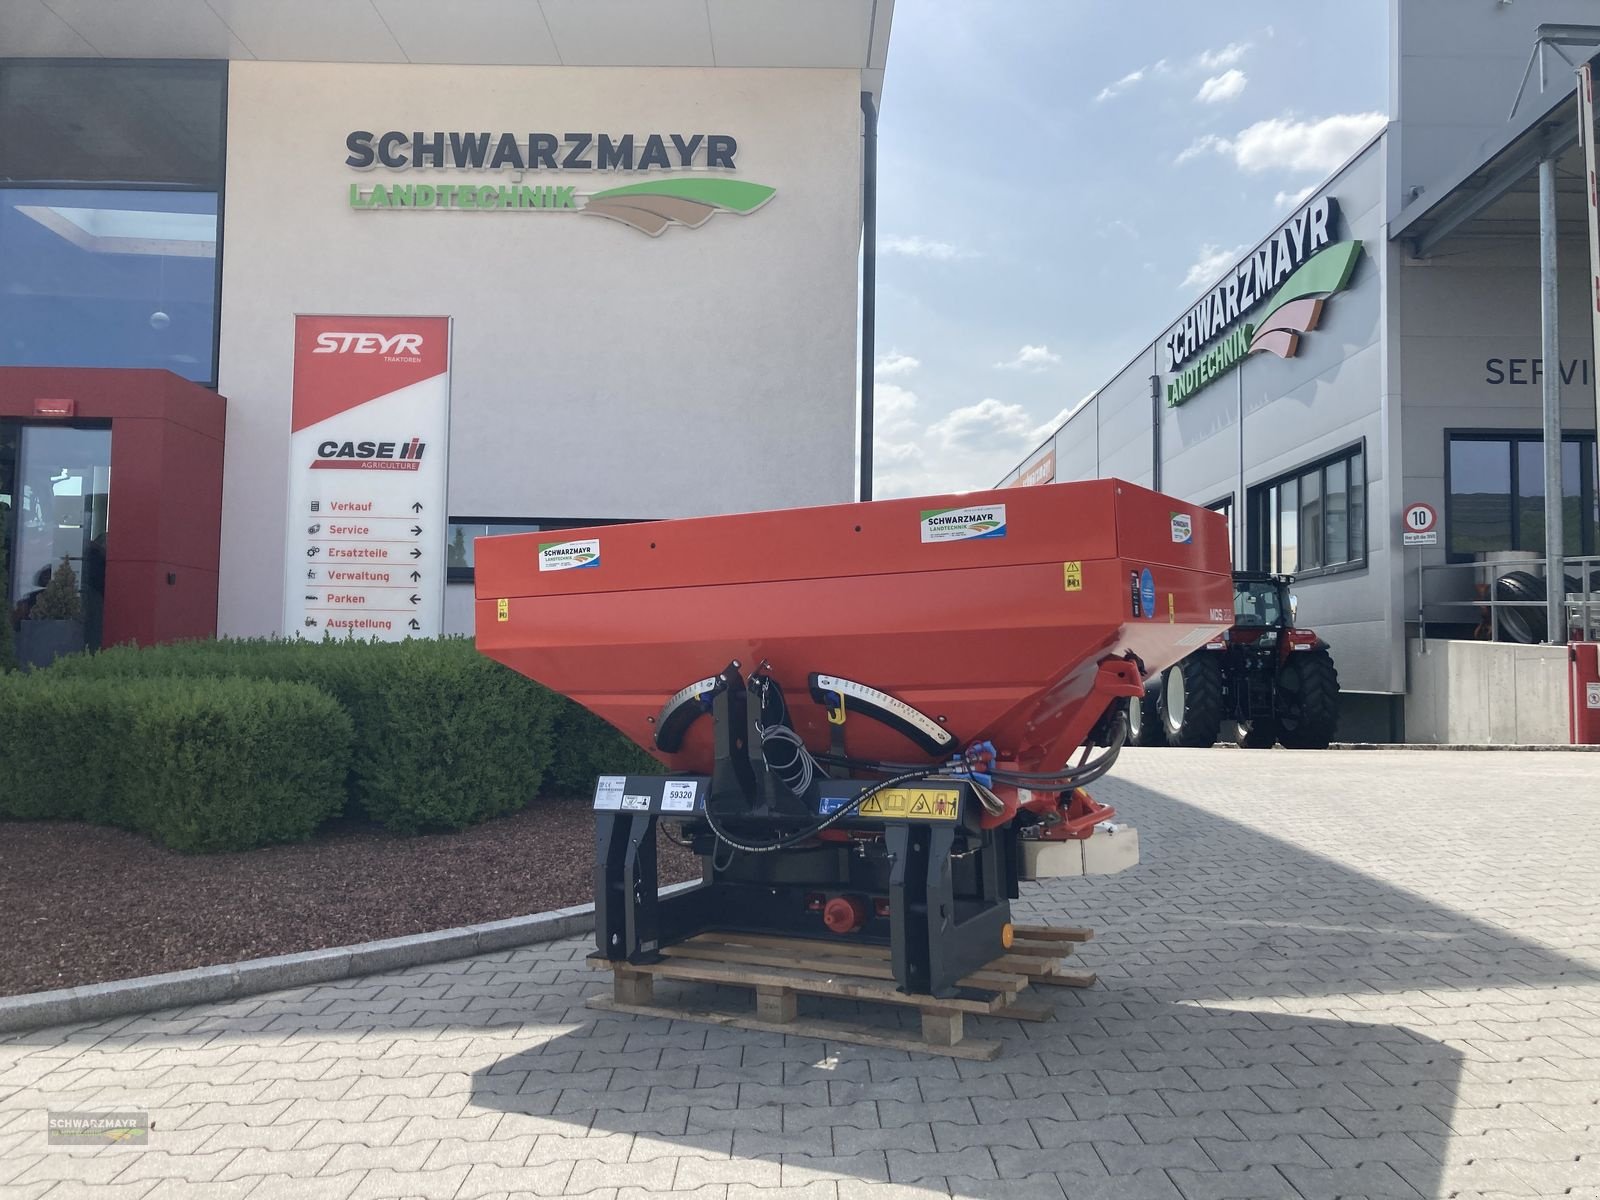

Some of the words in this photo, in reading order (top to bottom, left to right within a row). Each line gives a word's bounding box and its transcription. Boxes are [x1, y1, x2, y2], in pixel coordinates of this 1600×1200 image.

[345, 130, 738, 171] SCHWARZMAYR
[349, 183, 579, 212] LANDTECHNIK
[1164, 196, 1336, 373] SCHWARZMAYR
[312, 332, 424, 355] STEYR
[384, 356, 422, 364] TRAKTOREN
[1167, 324, 1254, 409] LANDTECHNIK
[317, 441, 396, 459] CASE
[361, 461, 417, 471] AGRICULTURE
[330, 502, 373, 512] Verkauf
[928, 514, 993, 526] SCHWARZMAYR
[1412, 511, 1426, 525] 10
[329, 525, 369, 536] Service
[328, 548, 388, 559] Ersatzteile
[544, 547, 591, 557] SCHWARZMAYR
[328, 571, 390, 583] Verwaltung
[327, 594, 366, 604] Parken
[326, 618, 392, 630] Ausstellung
[669, 791, 693, 799] 59320
